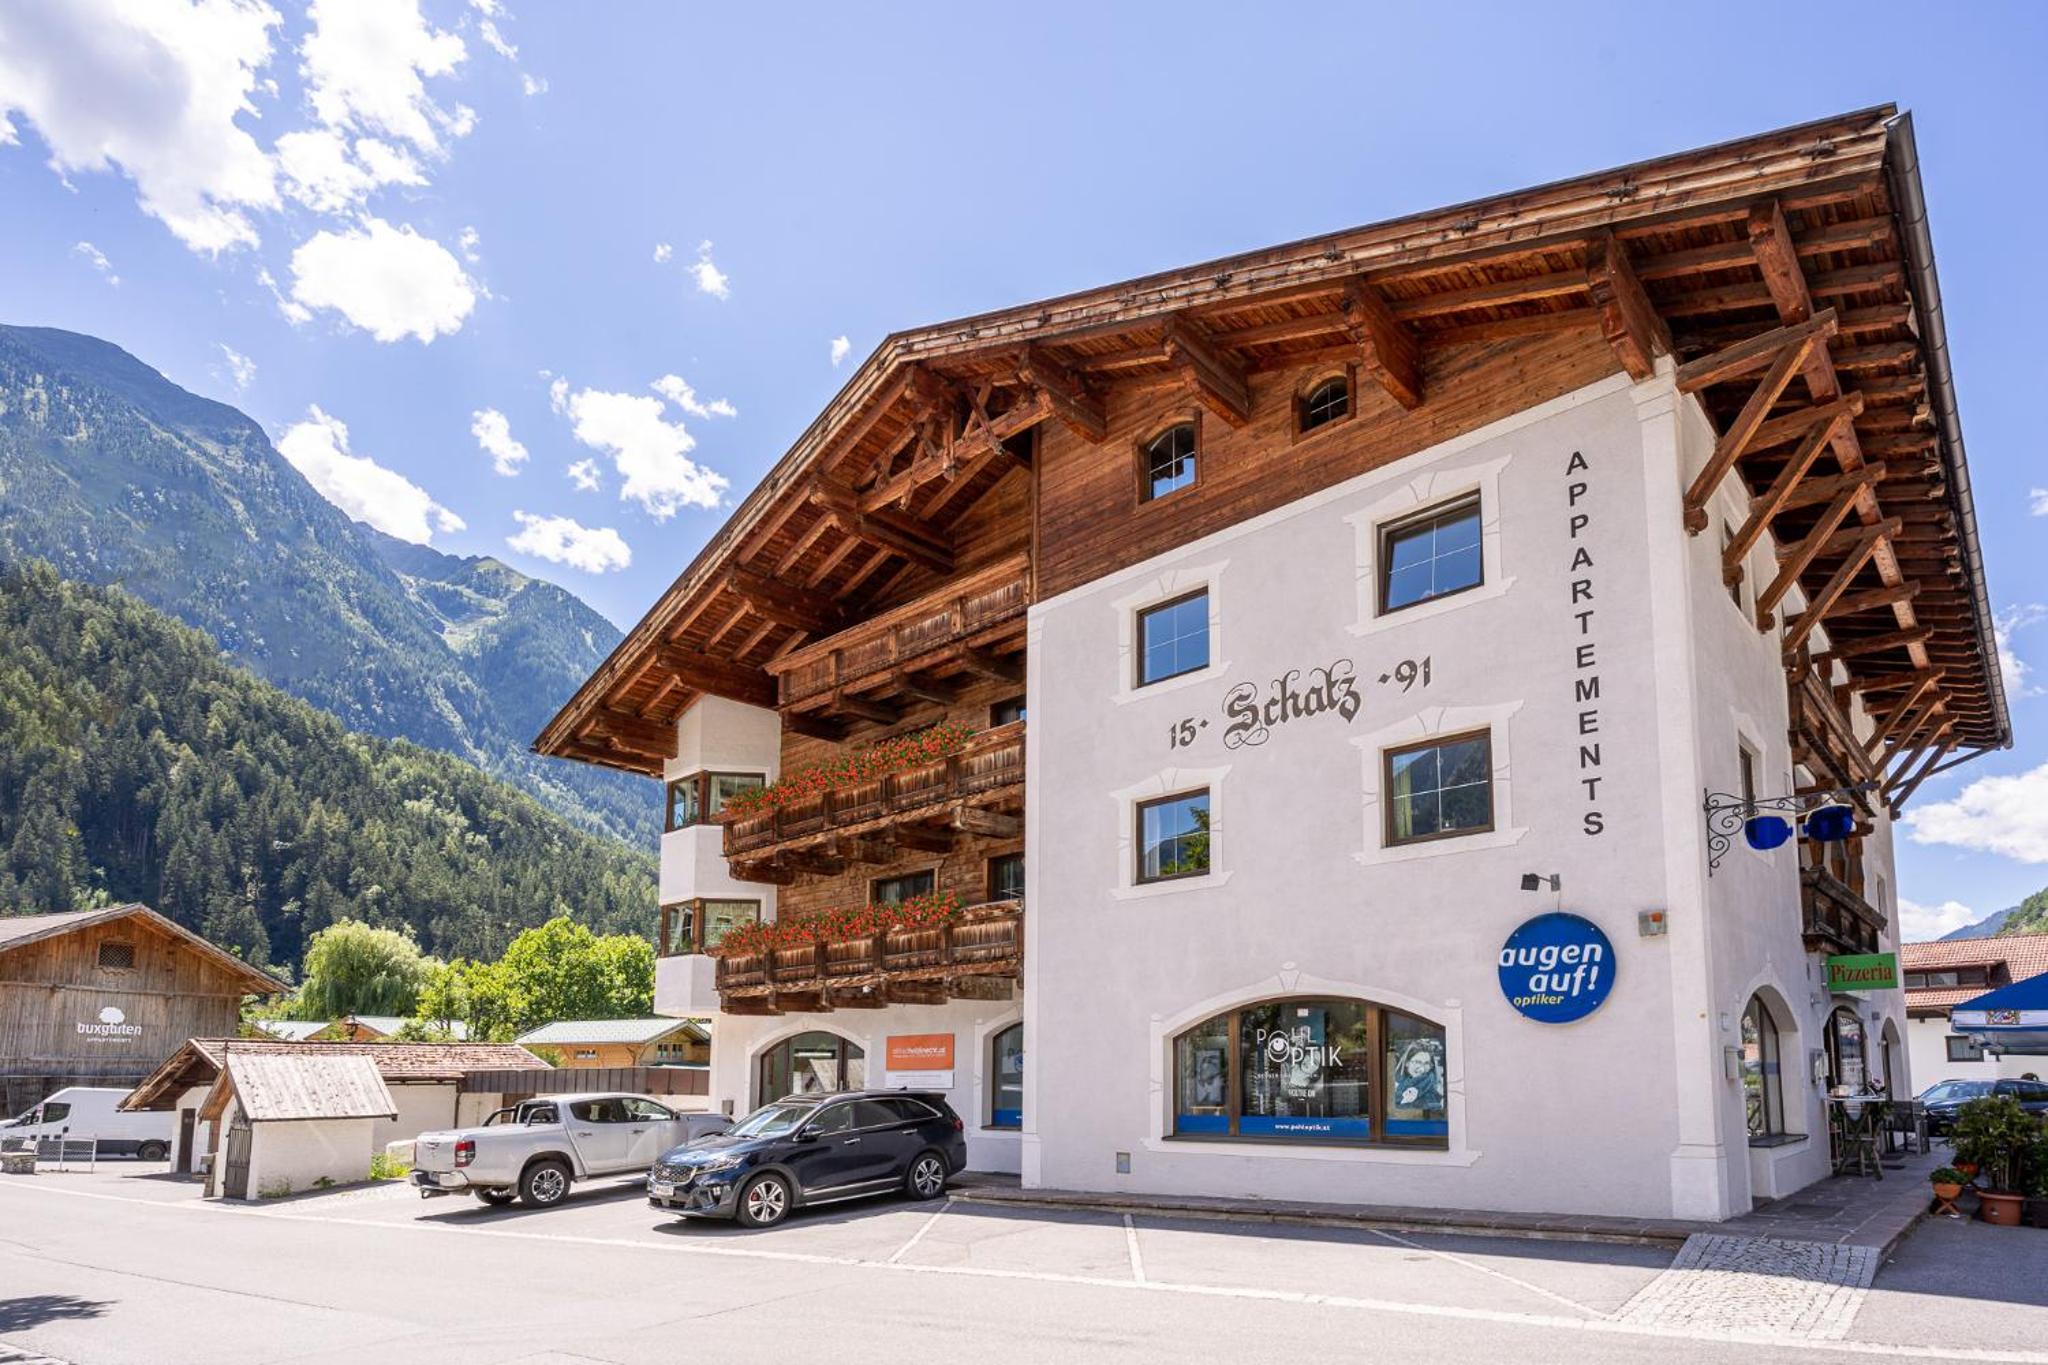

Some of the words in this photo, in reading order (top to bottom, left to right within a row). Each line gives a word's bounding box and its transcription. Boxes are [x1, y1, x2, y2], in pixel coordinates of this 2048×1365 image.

[1565, 451, 1604, 836] APPARTEMENTS
[1222, 659, 1362, 750] Schatz
[1499, 943, 1602, 971] augen
[1529, 964, 1599, 997] auf!
[1830, 963, 1893, 983] Pizzeria
[1513, 993, 1565, 1008] optiker
